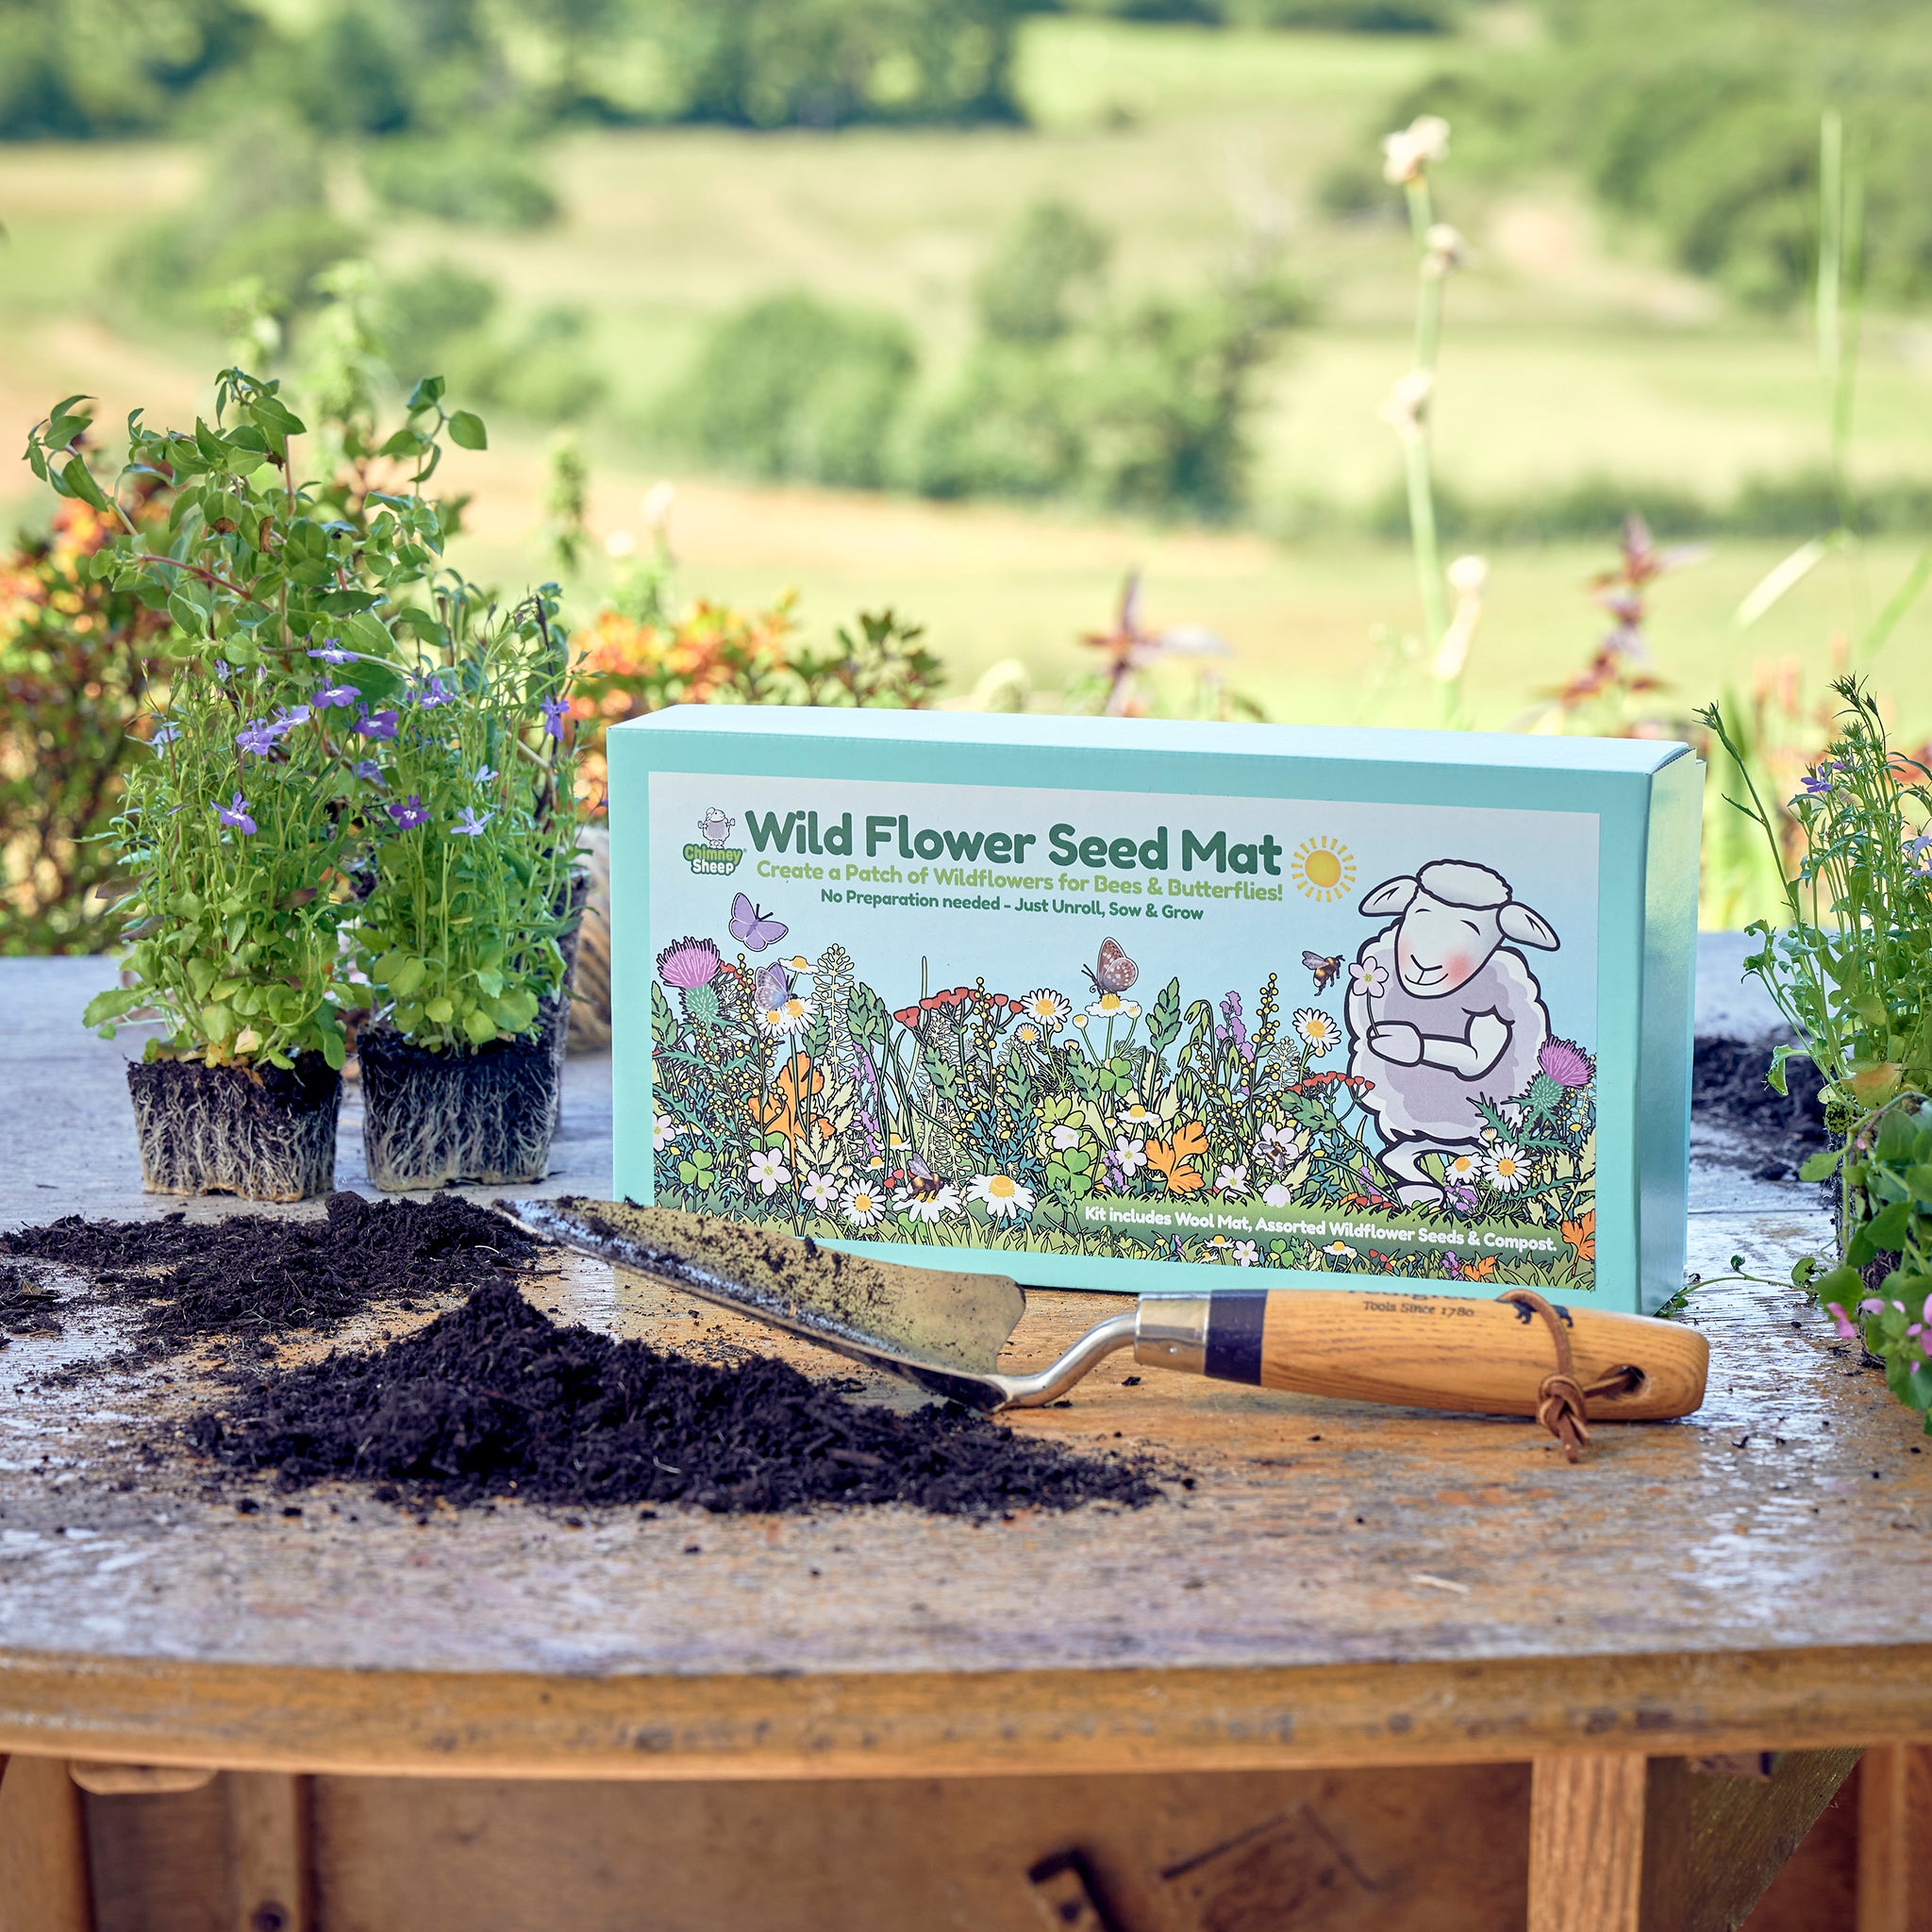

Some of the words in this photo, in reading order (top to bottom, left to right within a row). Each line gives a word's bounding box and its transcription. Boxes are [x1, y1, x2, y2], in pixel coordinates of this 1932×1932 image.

[684, 844, 741, 865] Chimney
[744, 809, 853, 854] Wild
[865, 815, 1037, 865] Flower
[1048, 823, 1169, 871] Seed
[1181, 829, 1283, 876] Mat
[692, 858, 735, 874] Sheep
[757, 860, 824, 881] Create
[828, 866, 841, 881] a
[845, 863, 903, 884] Patch
[908, 867, 929, 885] of
[933, 868, 1054, 891] Wildflowers
[1058, 873, 1090, 893] for
[1093, 874, 1142, 895] Bees
[1147, 877, 1163, 896] &
[1168, 878, 1283, 902] Butterflies!
[821, 889, 843, 904] No
[846, 890, 940, 909] Preparation
[942, 894, 1001, 911] needed
[1014, 897, 1049, 913] Just
[1052, 899, 1106, 918] Unroll,
[1108, 903, 1142, 918] Sow
[1145, 905, 1158, 919] &
[1161, 905, 1205, 920] Grow
[1085, 1206, 1107, 1223] Kit
[1108, 1207, 1173, 1225] includes
[1174, 1211, 1215, 1228] Wool
[1217, 1213, 1253, 1233] Mat,
[1255, 1217, 1326, 1236] Assorted
[1328, 1222, 1415, 1241] Wildflower
[1418, 1228, 1465, 1244] Seeds
[1468, 1231, 1481, 1246] &
[1483, 1234, 1557, 1253] Compost.
[1362, 1300, 1397, 1312] Tools
[1400, 1302, 1437, 1314] Since
[1441, 1306, 1474, 1317] 1780
